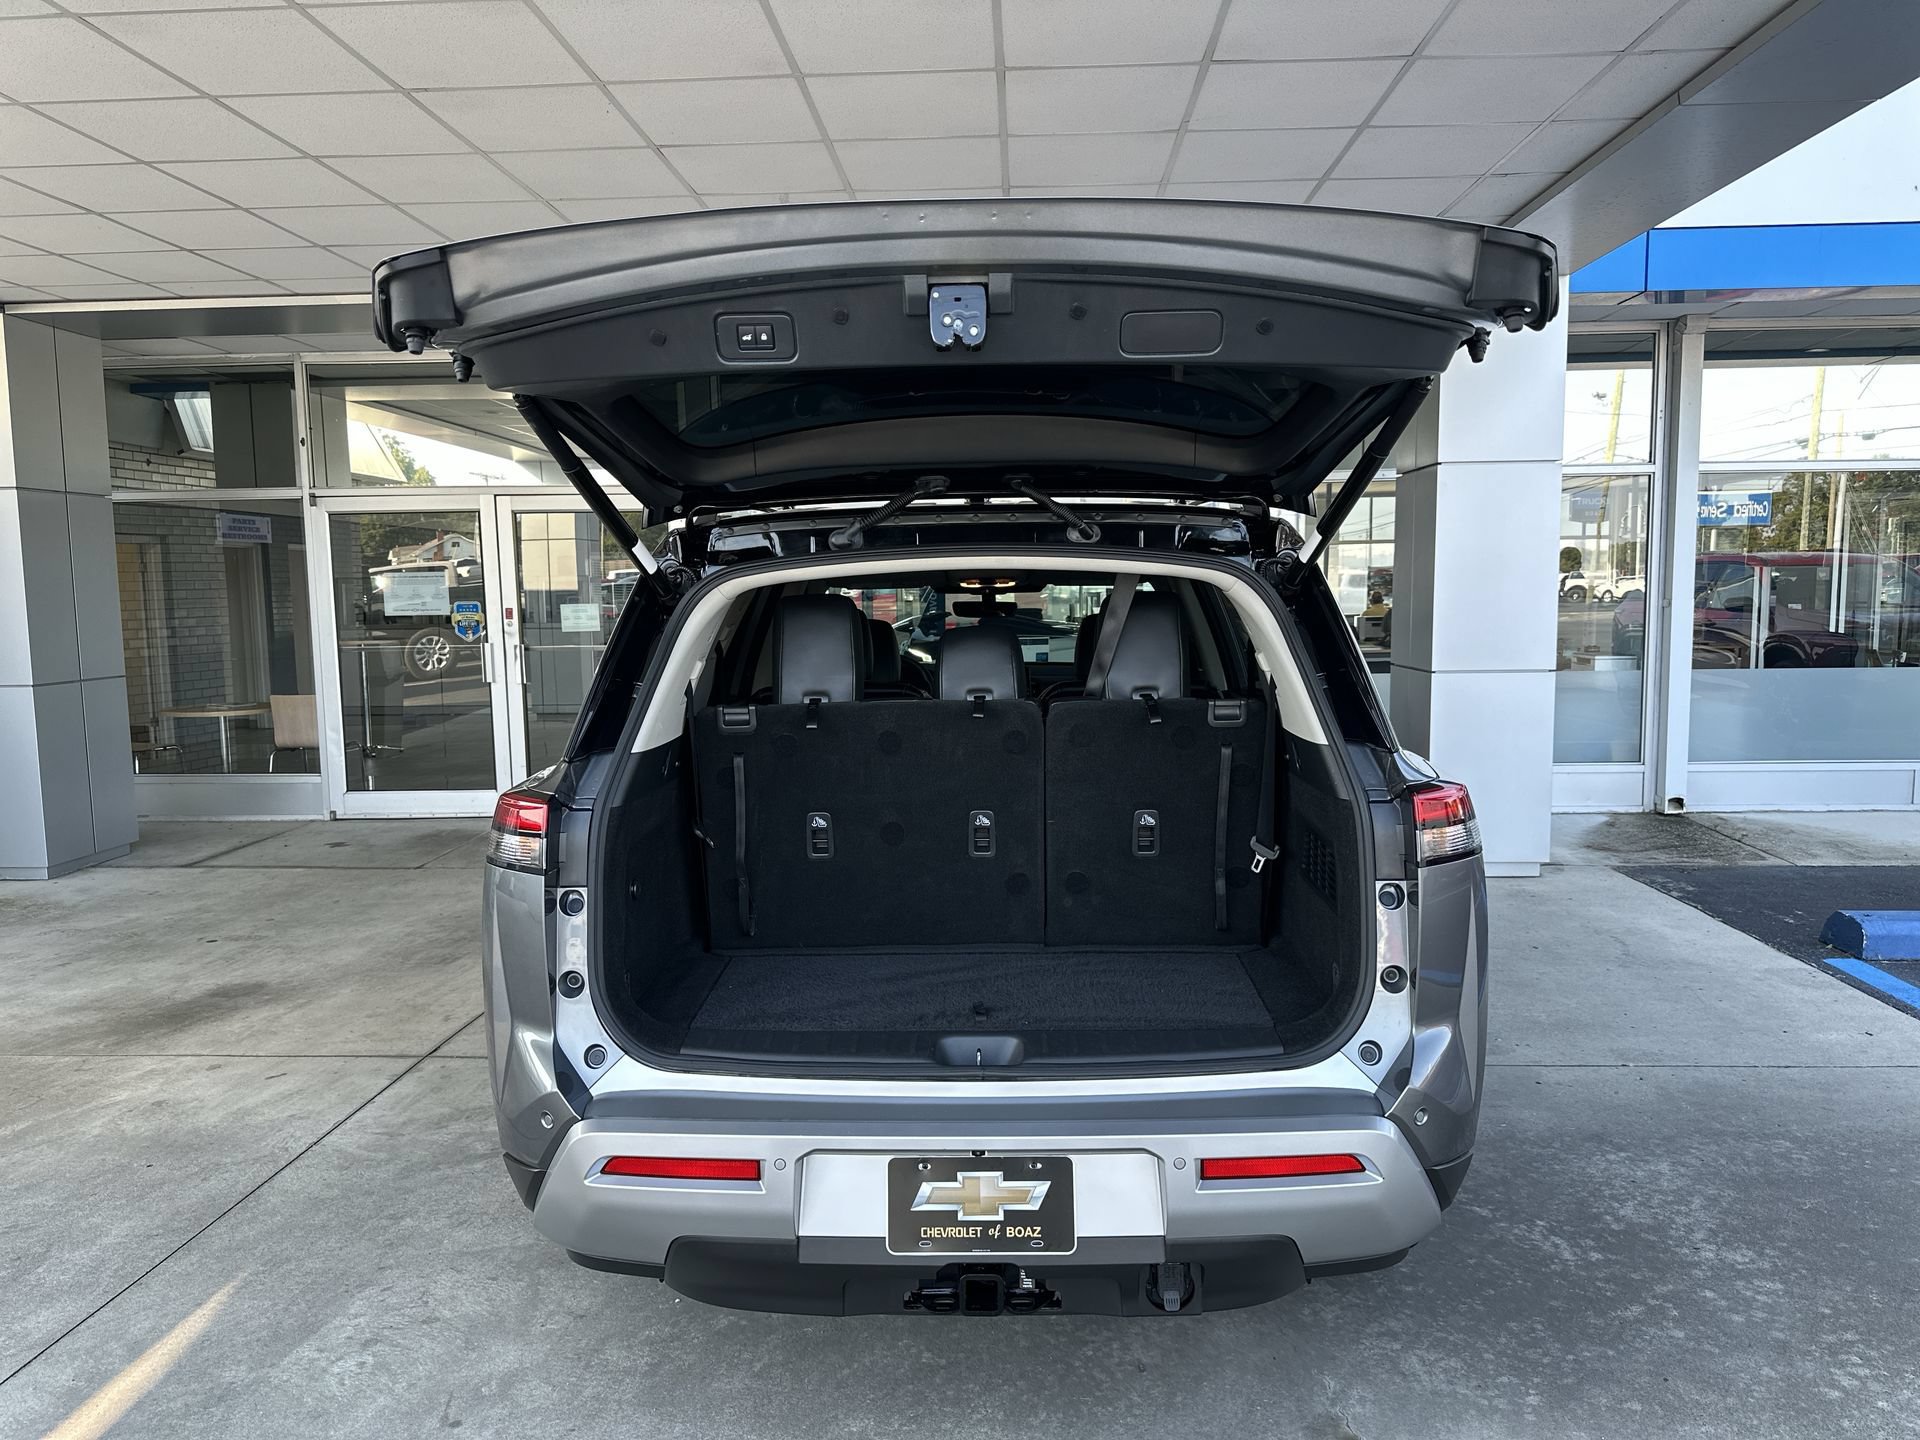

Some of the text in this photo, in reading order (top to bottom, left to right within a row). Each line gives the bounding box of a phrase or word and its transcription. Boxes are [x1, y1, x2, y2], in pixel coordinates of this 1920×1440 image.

[232, 517, 257, 525] PARTS
[228, 525, 261, 533] SERVICE
[222, 532, 268, 540] RESTROOMS
[920, 1224, 1042, 1239] CHEVROLET of BOAZ
